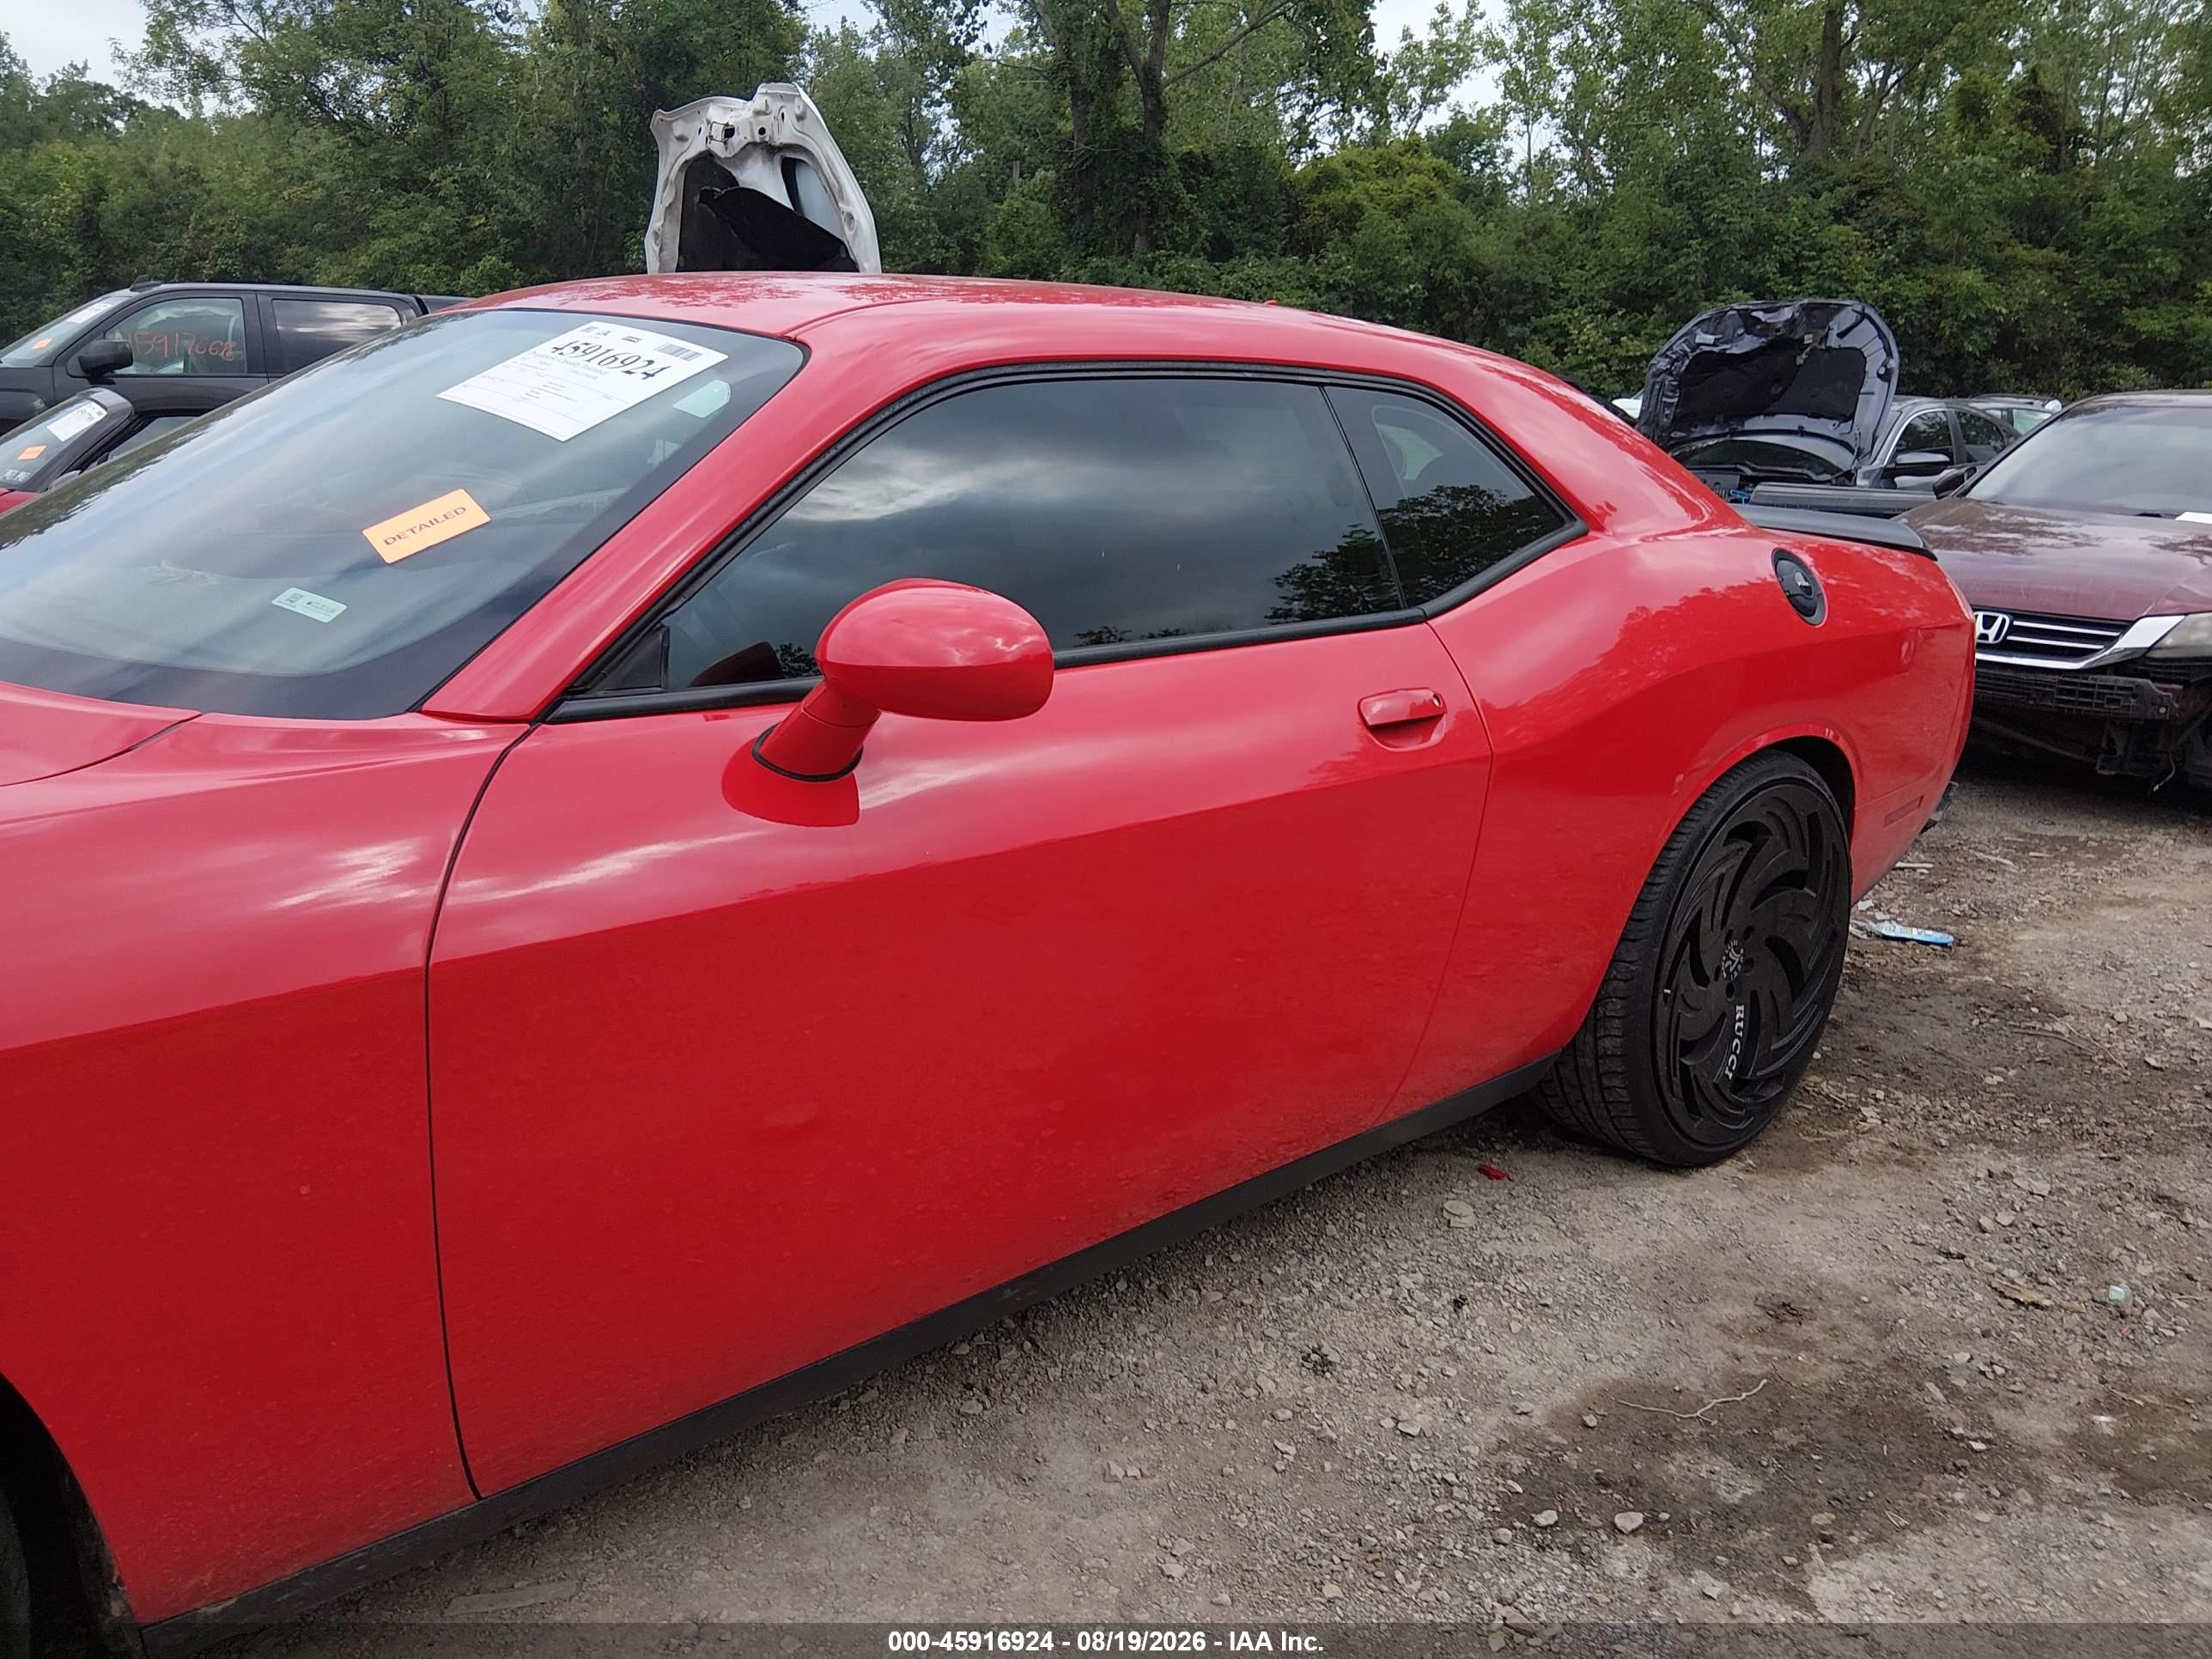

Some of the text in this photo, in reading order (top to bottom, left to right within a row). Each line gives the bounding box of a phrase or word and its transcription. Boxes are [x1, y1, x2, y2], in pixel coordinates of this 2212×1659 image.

[551, 340, 672, 380] 45916924
[383, 507, 467, 545] DETAILED
[1724, 1004, 1745, 1080] RUCCI
